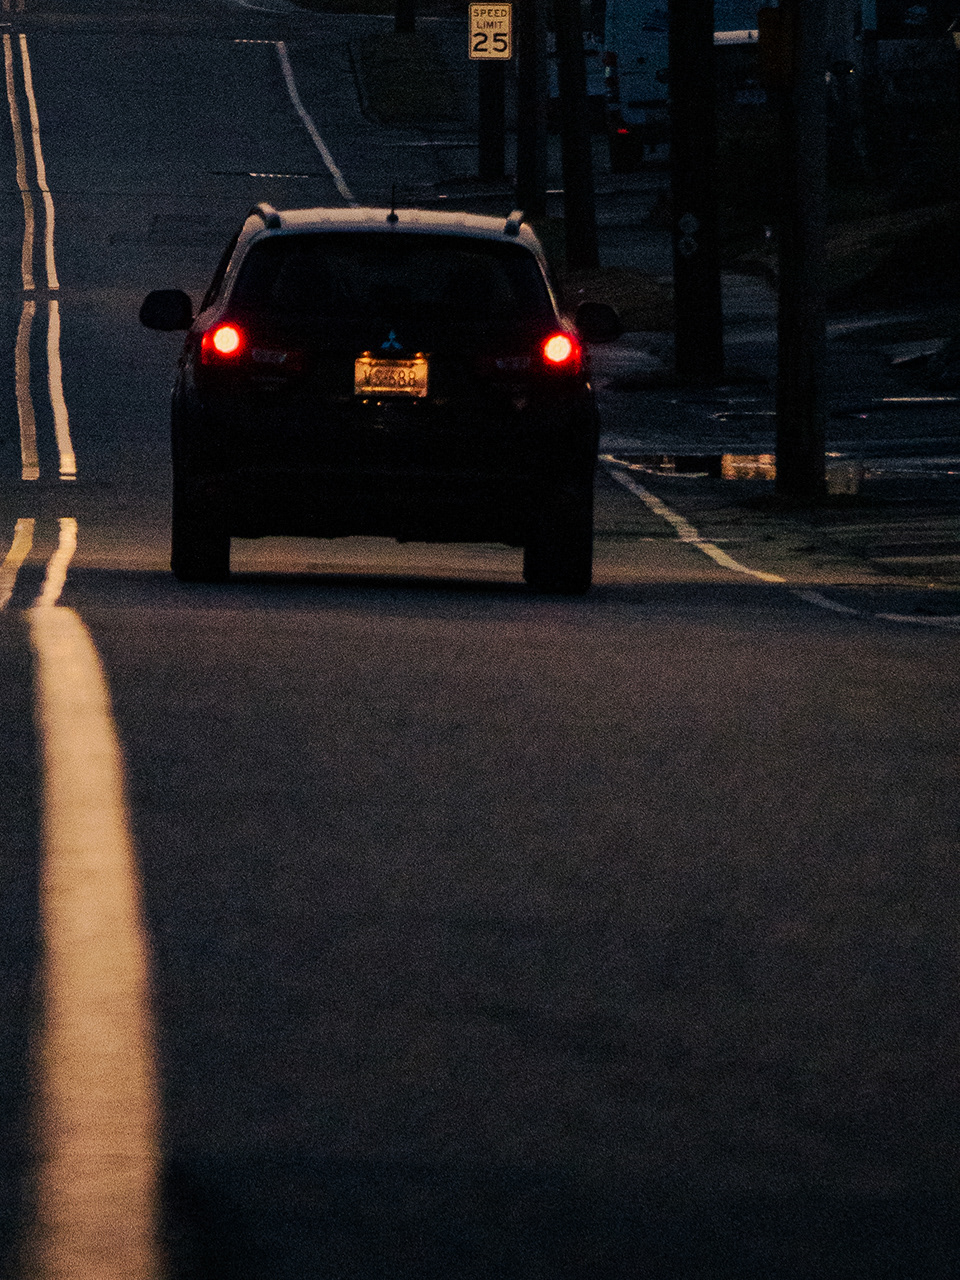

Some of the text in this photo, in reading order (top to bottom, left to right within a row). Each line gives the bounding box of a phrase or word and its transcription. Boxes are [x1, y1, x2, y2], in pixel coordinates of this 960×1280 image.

[473, 9, 508, 18] SPEED
[476, 21, 504, 29] LIMIT
[473, 32, 508, 53] 25
